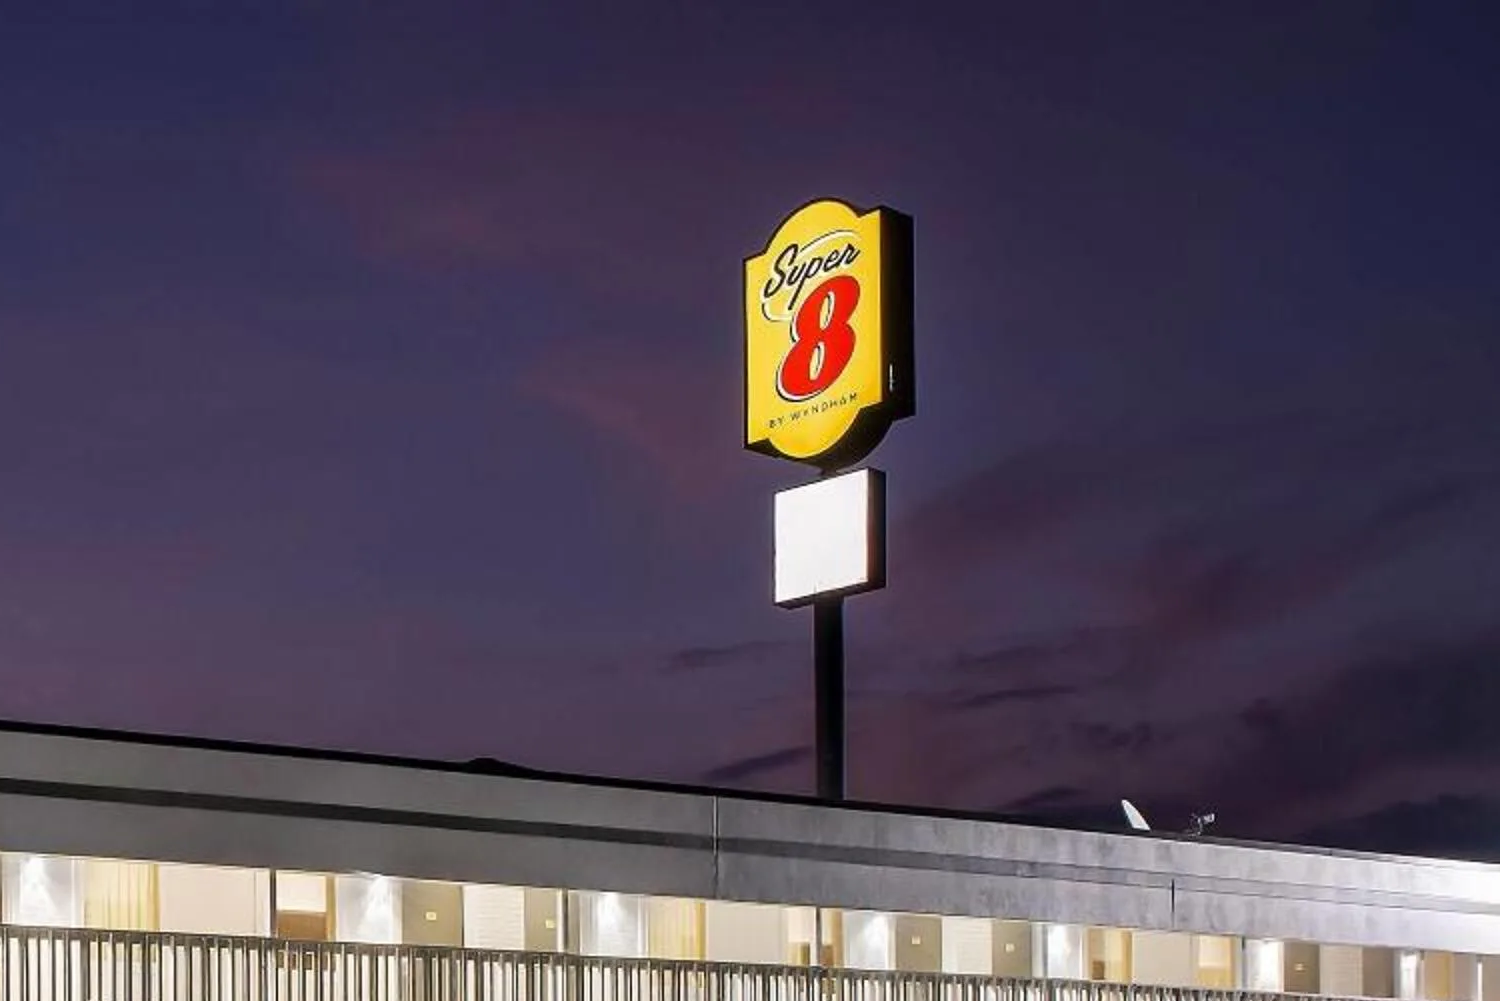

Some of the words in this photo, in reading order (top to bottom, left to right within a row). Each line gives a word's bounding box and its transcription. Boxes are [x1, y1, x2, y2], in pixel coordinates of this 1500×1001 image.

[764, 240, 861, 310] Super
[776, 275, 861, 402] 8
[769, 415, 785, 429] BY
[789, 392, 858, 421] WYNDHAM
